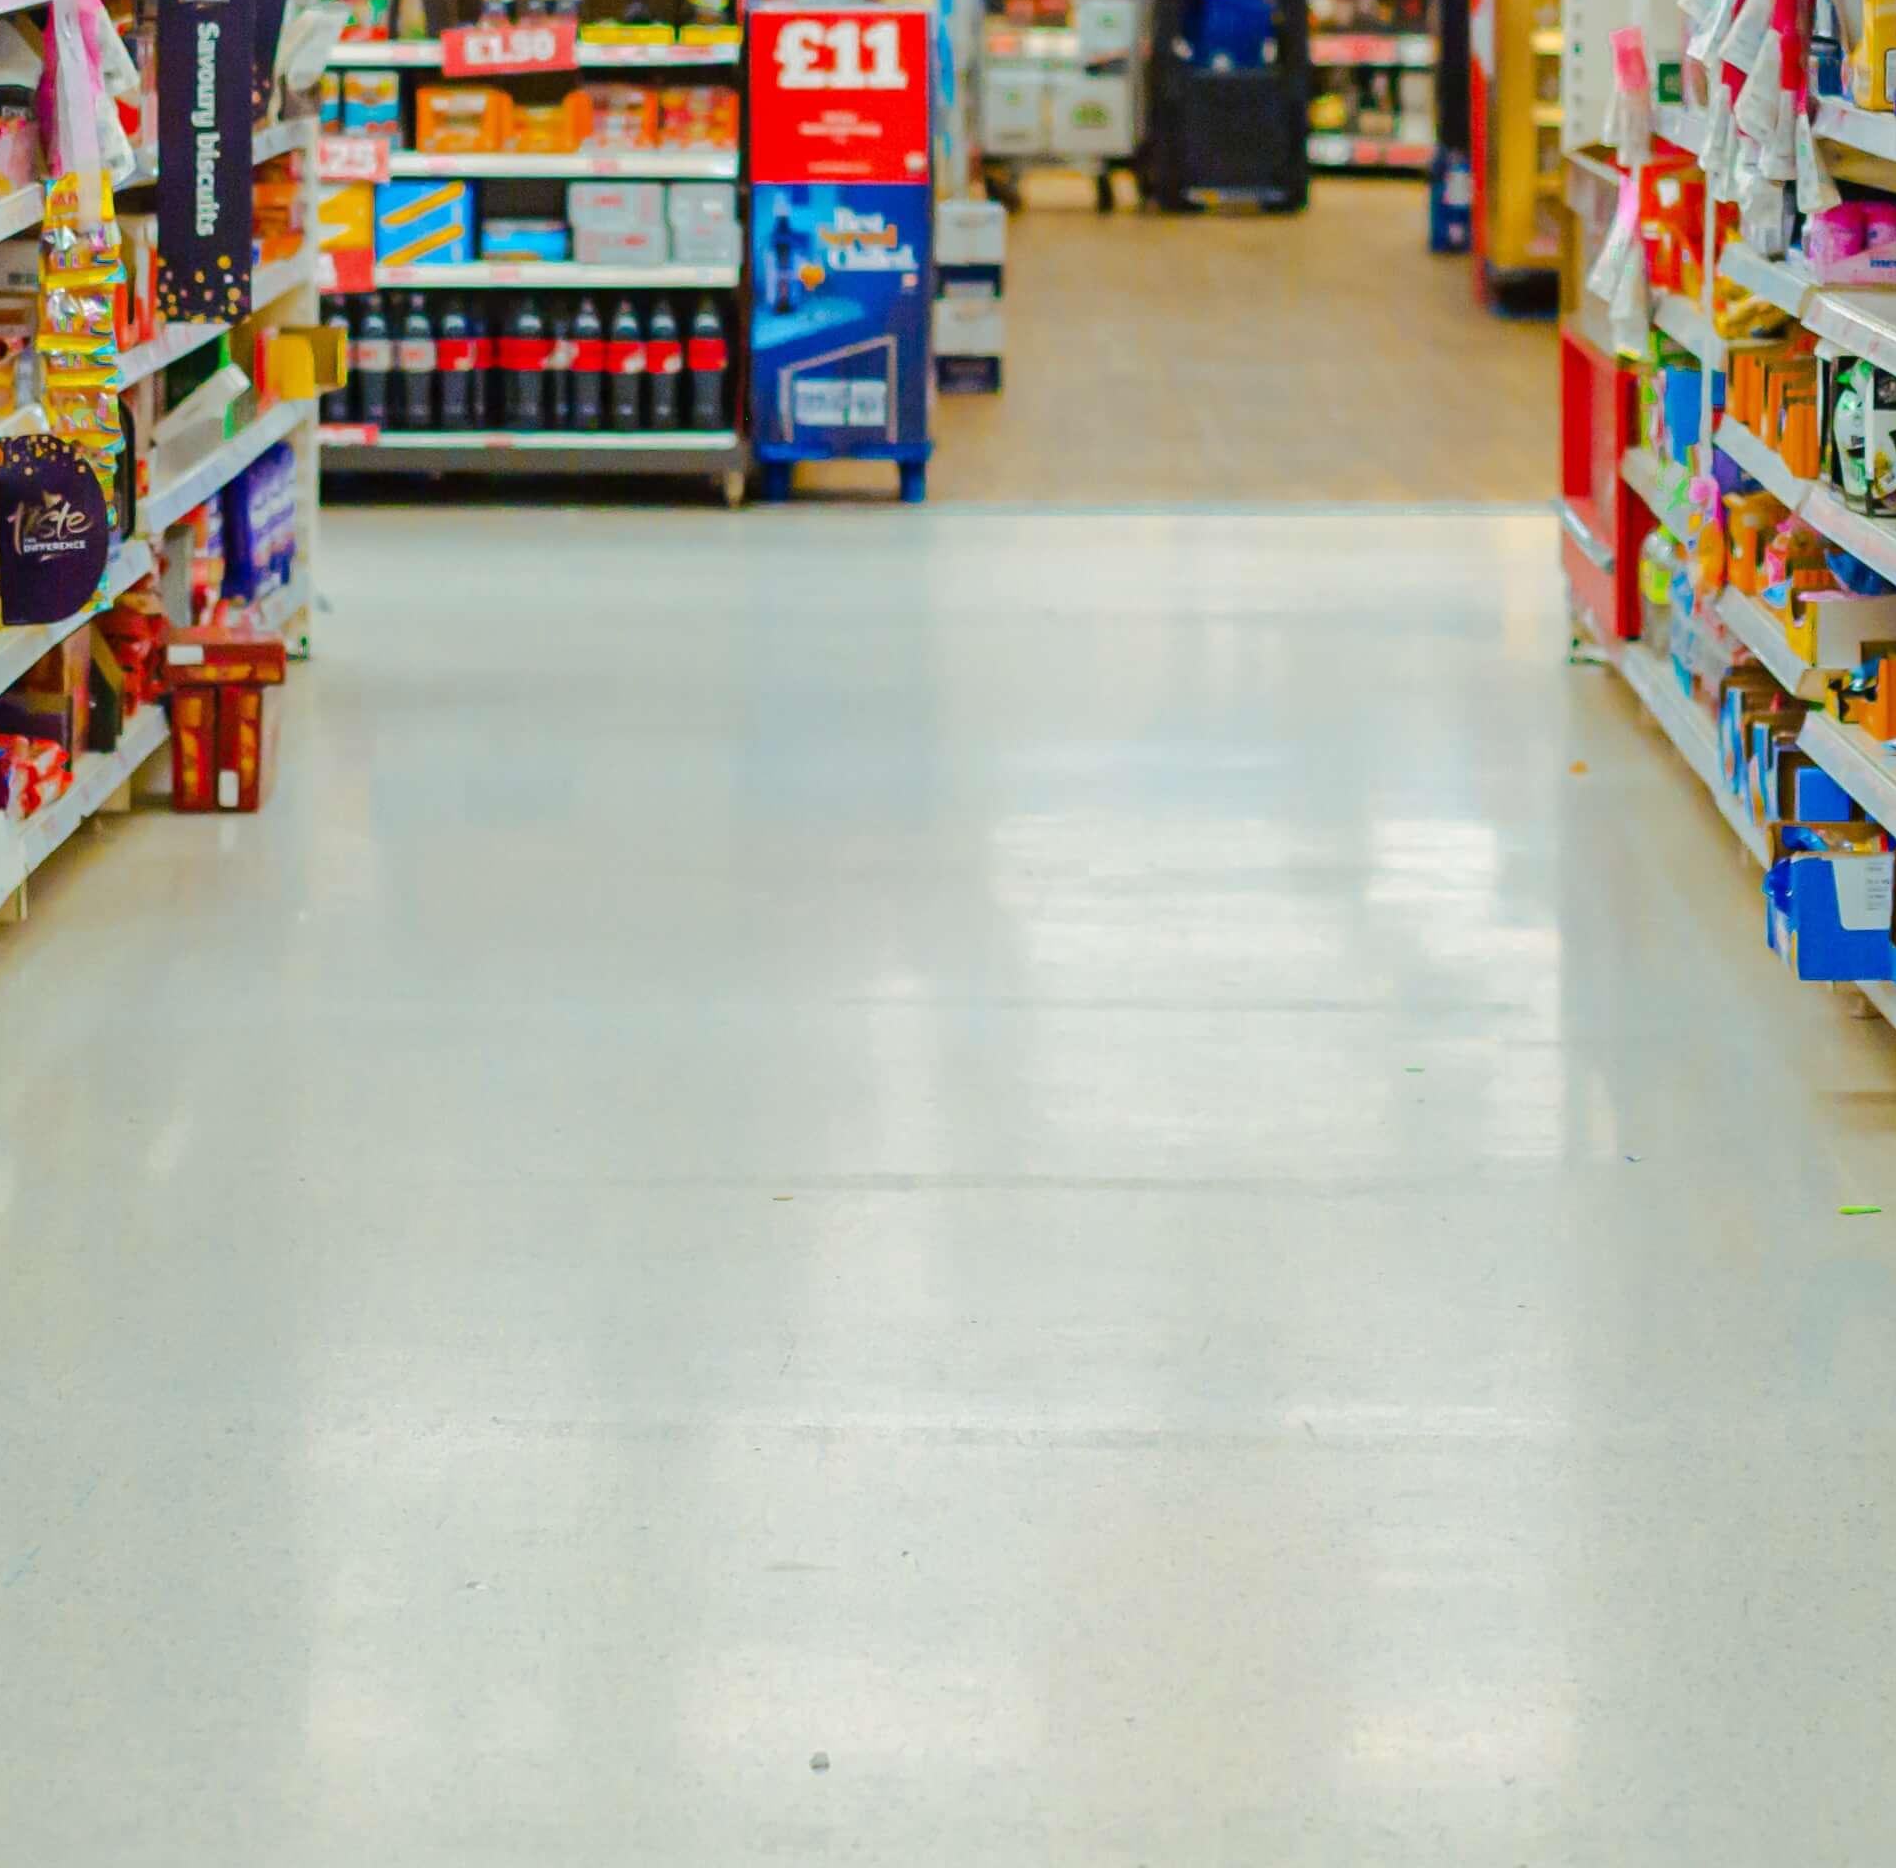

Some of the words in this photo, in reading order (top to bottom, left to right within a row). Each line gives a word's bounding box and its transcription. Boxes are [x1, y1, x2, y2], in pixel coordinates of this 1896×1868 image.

[190, 21, 221, 129] Savoury
[773, 19, 909, 90] £11
[195, 131, 222, 238] biscuits
[22, 540, 87, 554] DIFFERENCE
